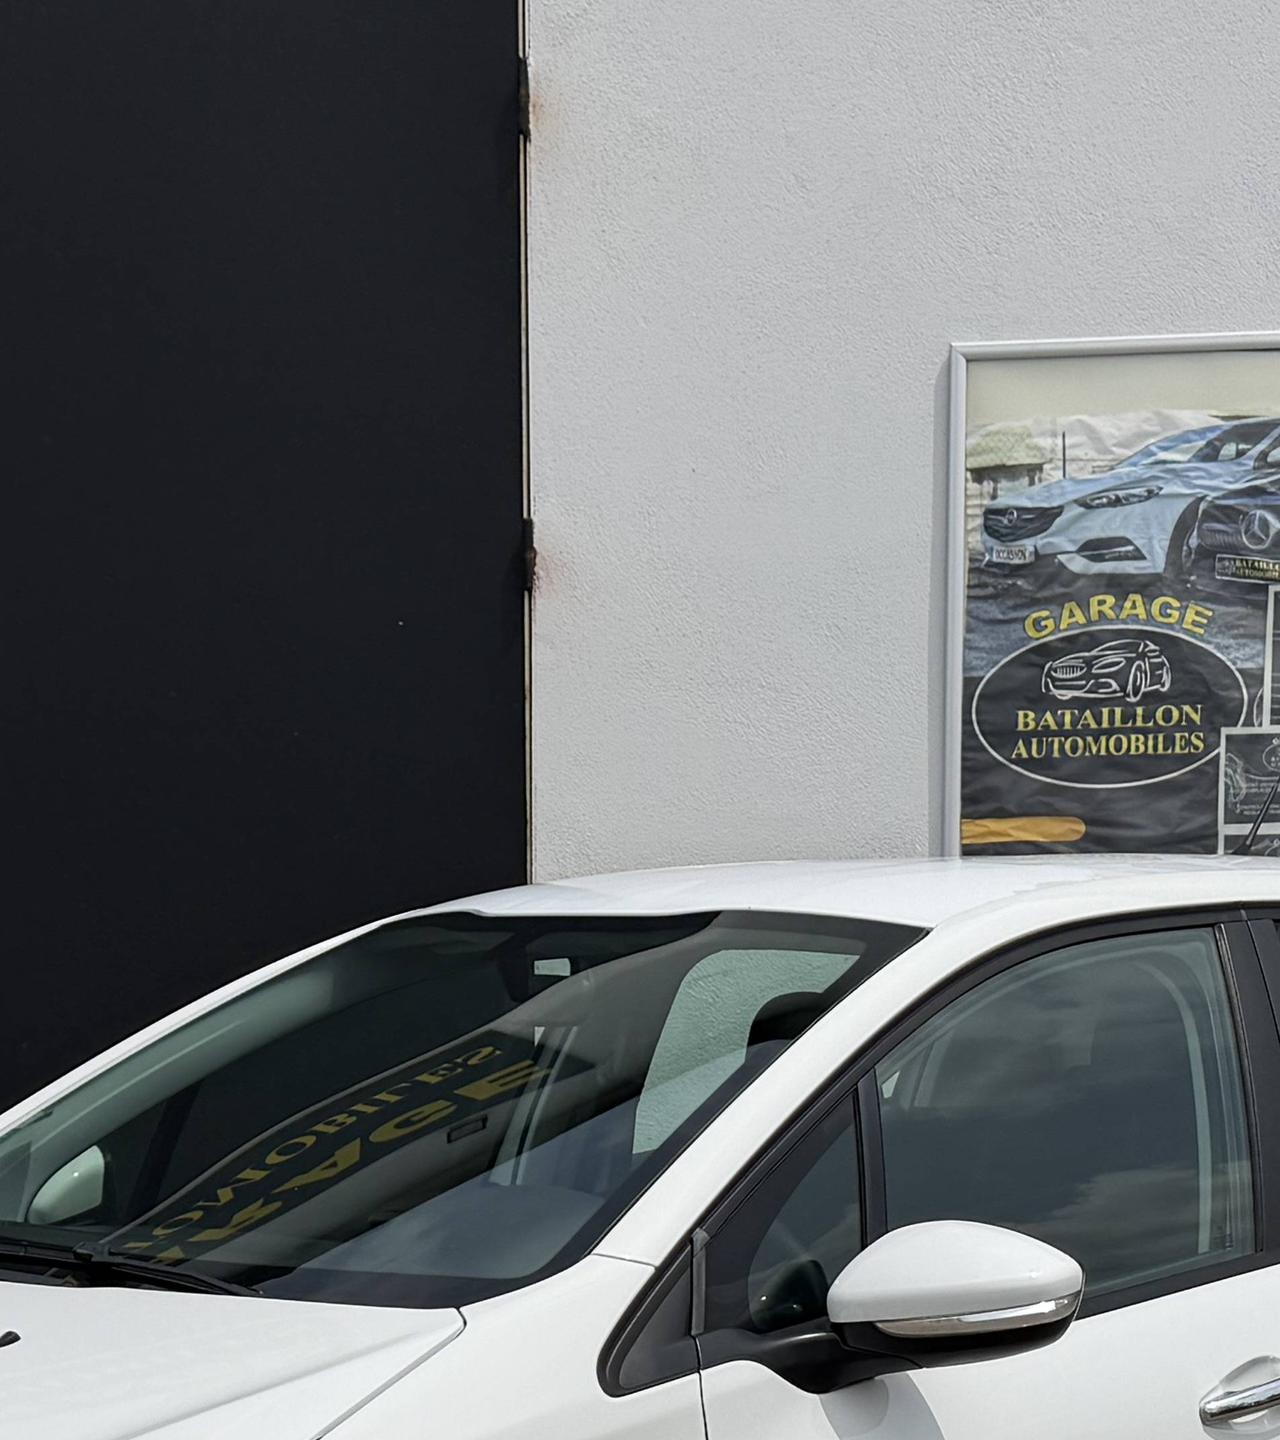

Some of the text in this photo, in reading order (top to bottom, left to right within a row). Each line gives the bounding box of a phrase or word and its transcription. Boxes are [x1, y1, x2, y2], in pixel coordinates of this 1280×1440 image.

[1023, 593, 1214, 640] GARAGE
[1016, 704, 1203, 731] BATAILLON
[1011, 732, 1205, 759] AUTOMOBILES
